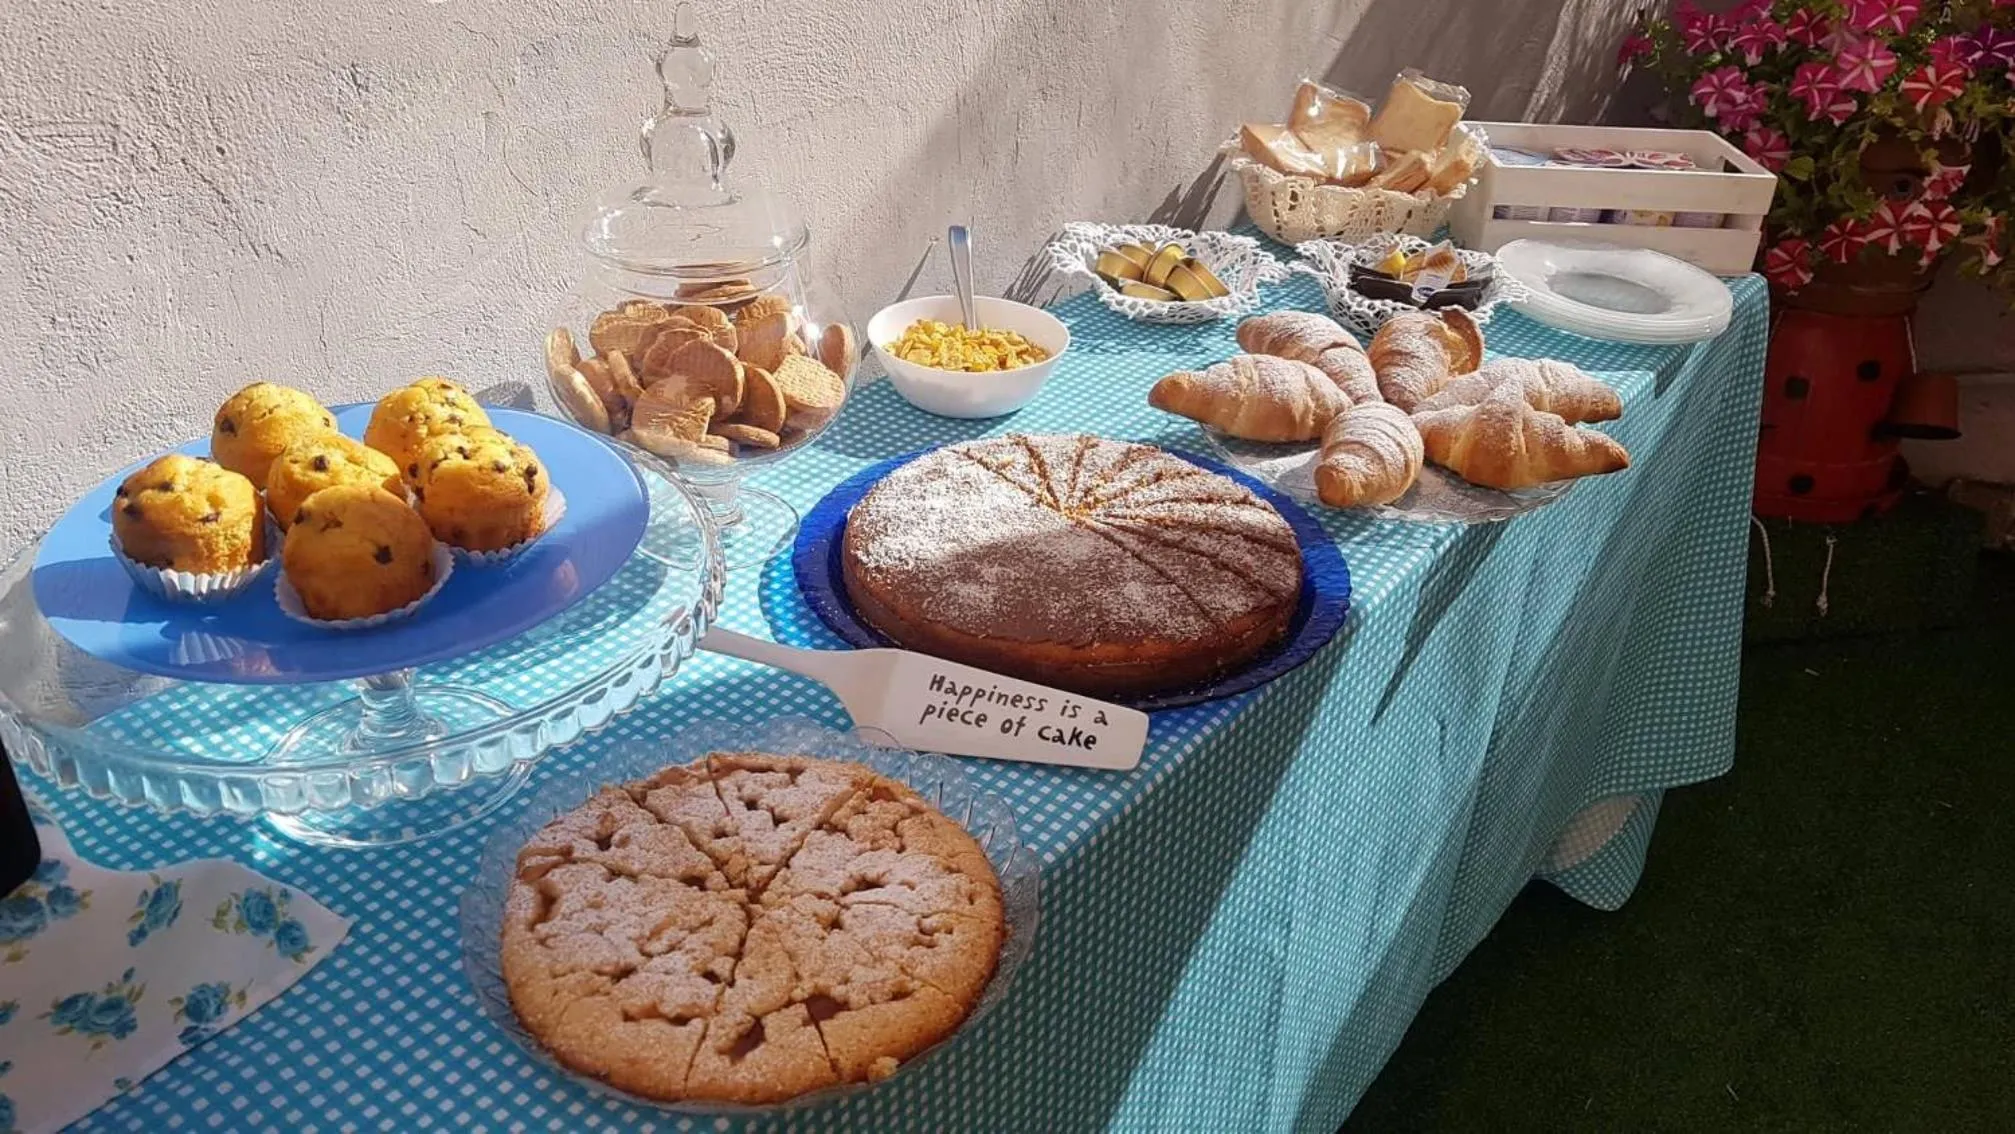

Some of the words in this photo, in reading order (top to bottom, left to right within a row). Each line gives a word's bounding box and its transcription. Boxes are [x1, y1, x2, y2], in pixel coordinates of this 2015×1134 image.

[918, 700, 988, 729] piece
[999, 715, 1027, 738] of
[928, 673, 1049, 712] Happiness
[1059, 699, 1083, 719] is
[1093, 710, 1109, 727] a
